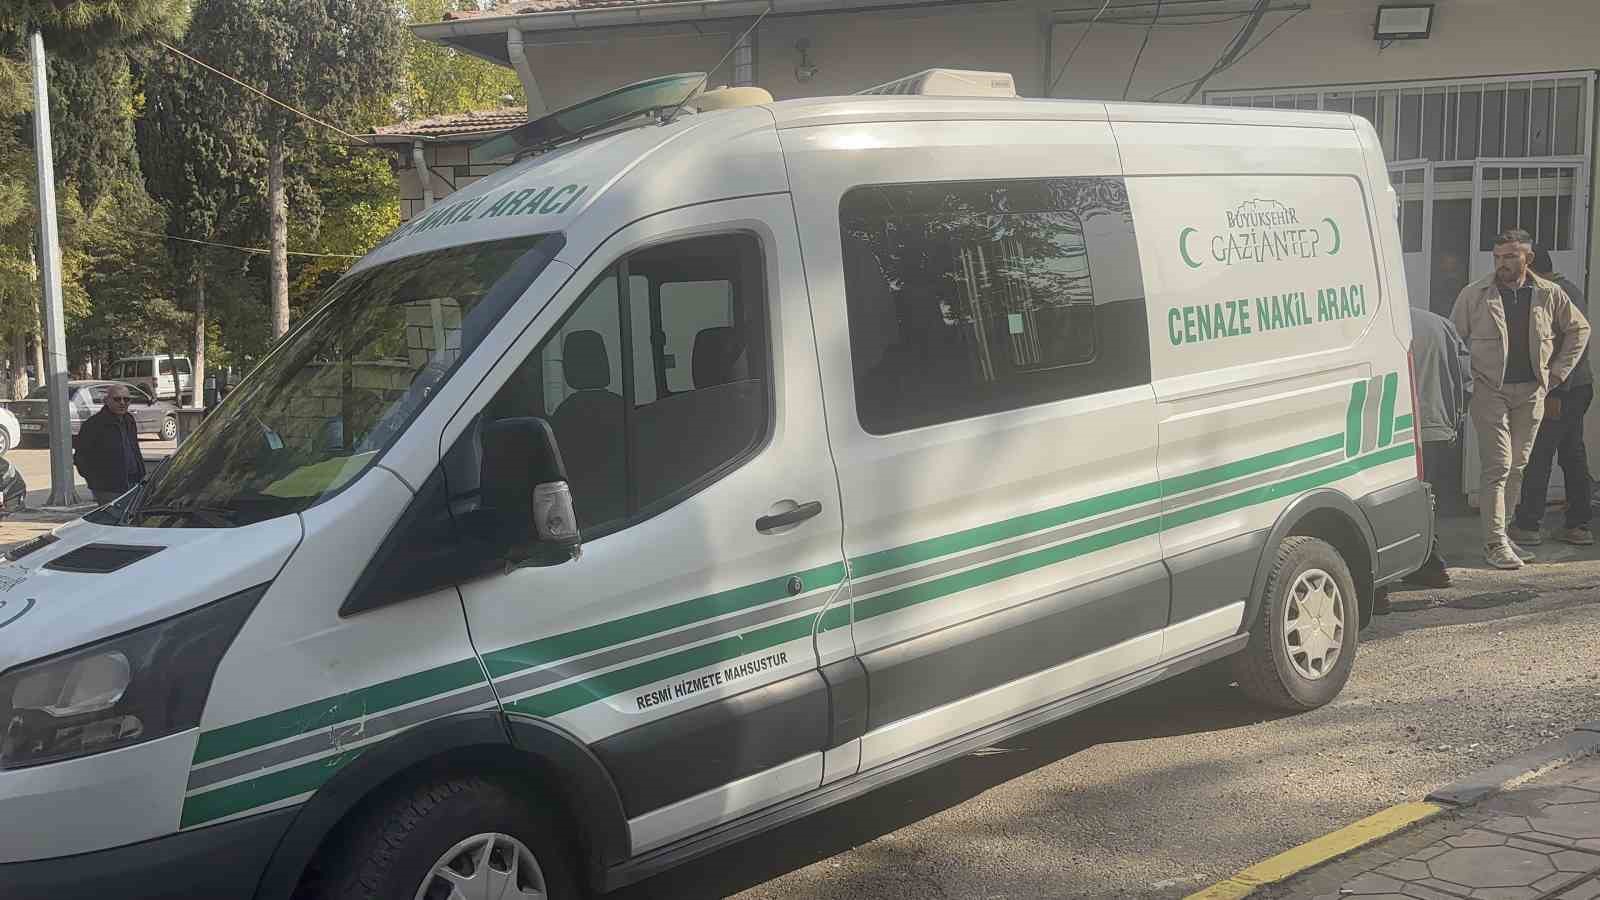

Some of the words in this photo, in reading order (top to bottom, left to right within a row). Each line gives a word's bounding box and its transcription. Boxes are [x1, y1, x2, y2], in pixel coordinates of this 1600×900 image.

[477, 184, 588, 220] ARACI
[1226, 207, 1299, 230] BÜYÜKŞEHİR
[1211, 228, 1320, 265] GAZİANTEP
[1168, 298, 1251, 345] CENAZE
[1256, 292, 1312, 332] NAKİL
[1317, 285, 1366, 322] ARACI
[636, 684, 672, 710] RESMİ
[674, 672, 723, 698] HİZMETE
[724, 652, 788, 682] MAHSUSTUR
